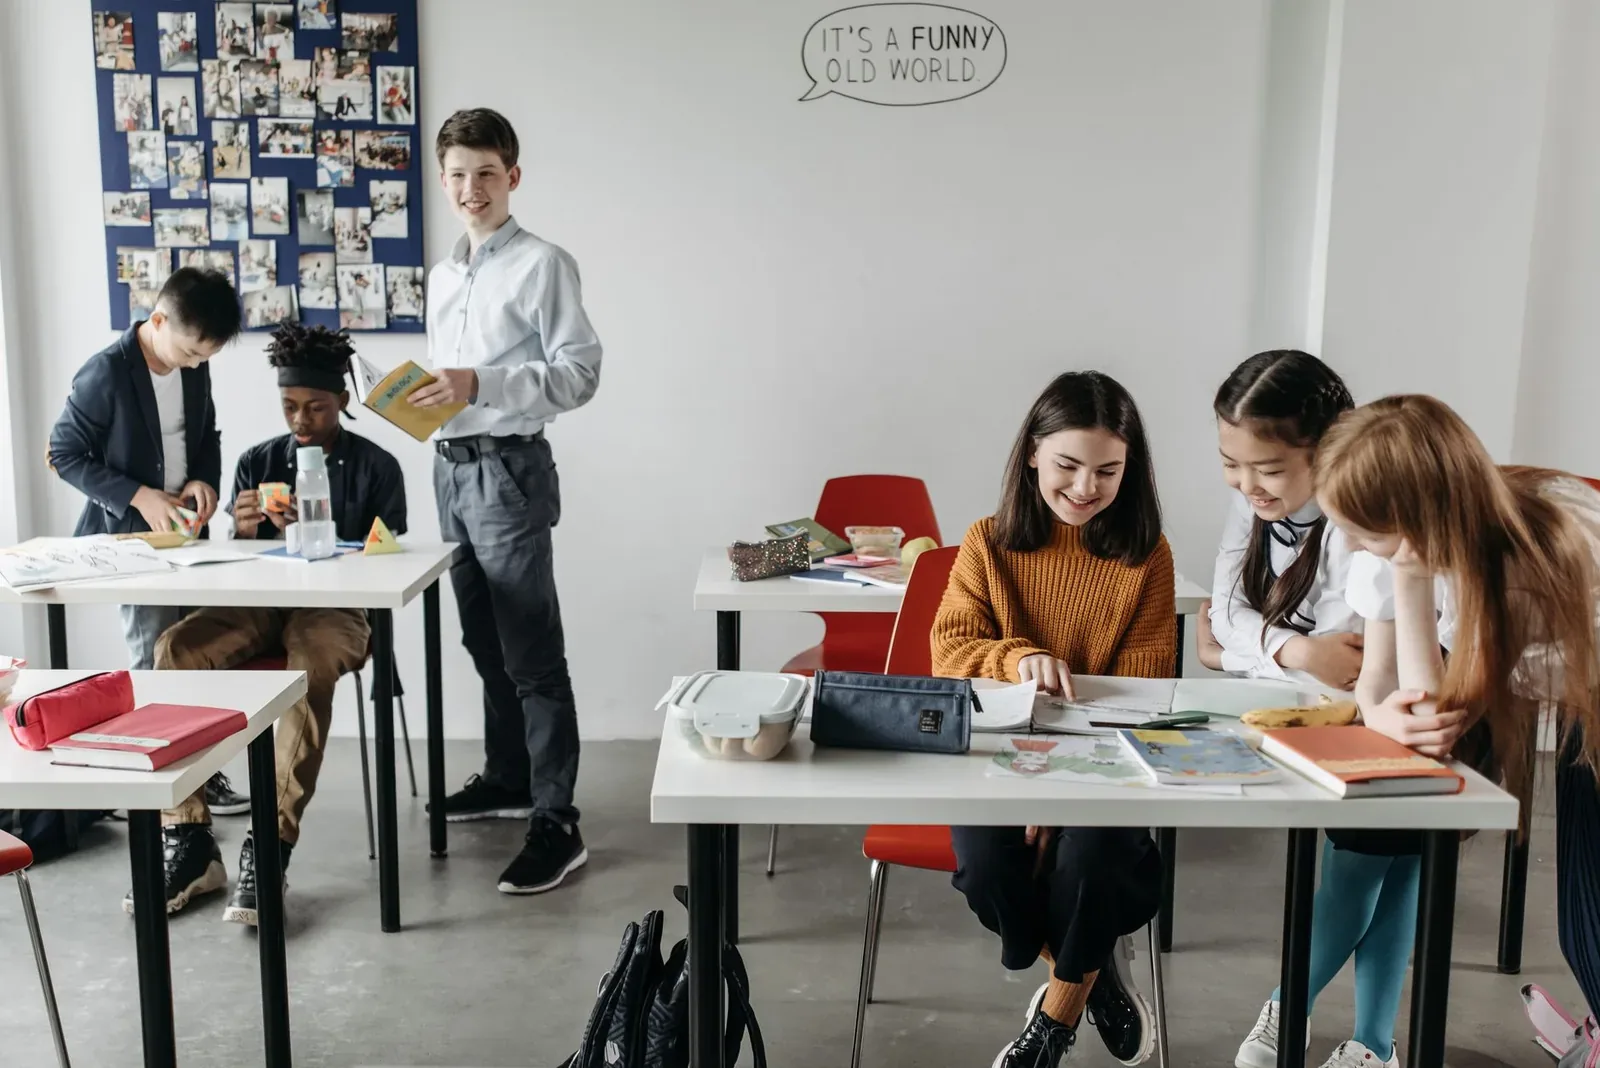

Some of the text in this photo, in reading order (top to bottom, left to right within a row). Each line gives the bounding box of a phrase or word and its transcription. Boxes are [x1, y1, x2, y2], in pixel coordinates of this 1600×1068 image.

[822, 24, 994, 53] IT'S A FUNNY
[826, 58, 876, 83] OLD
